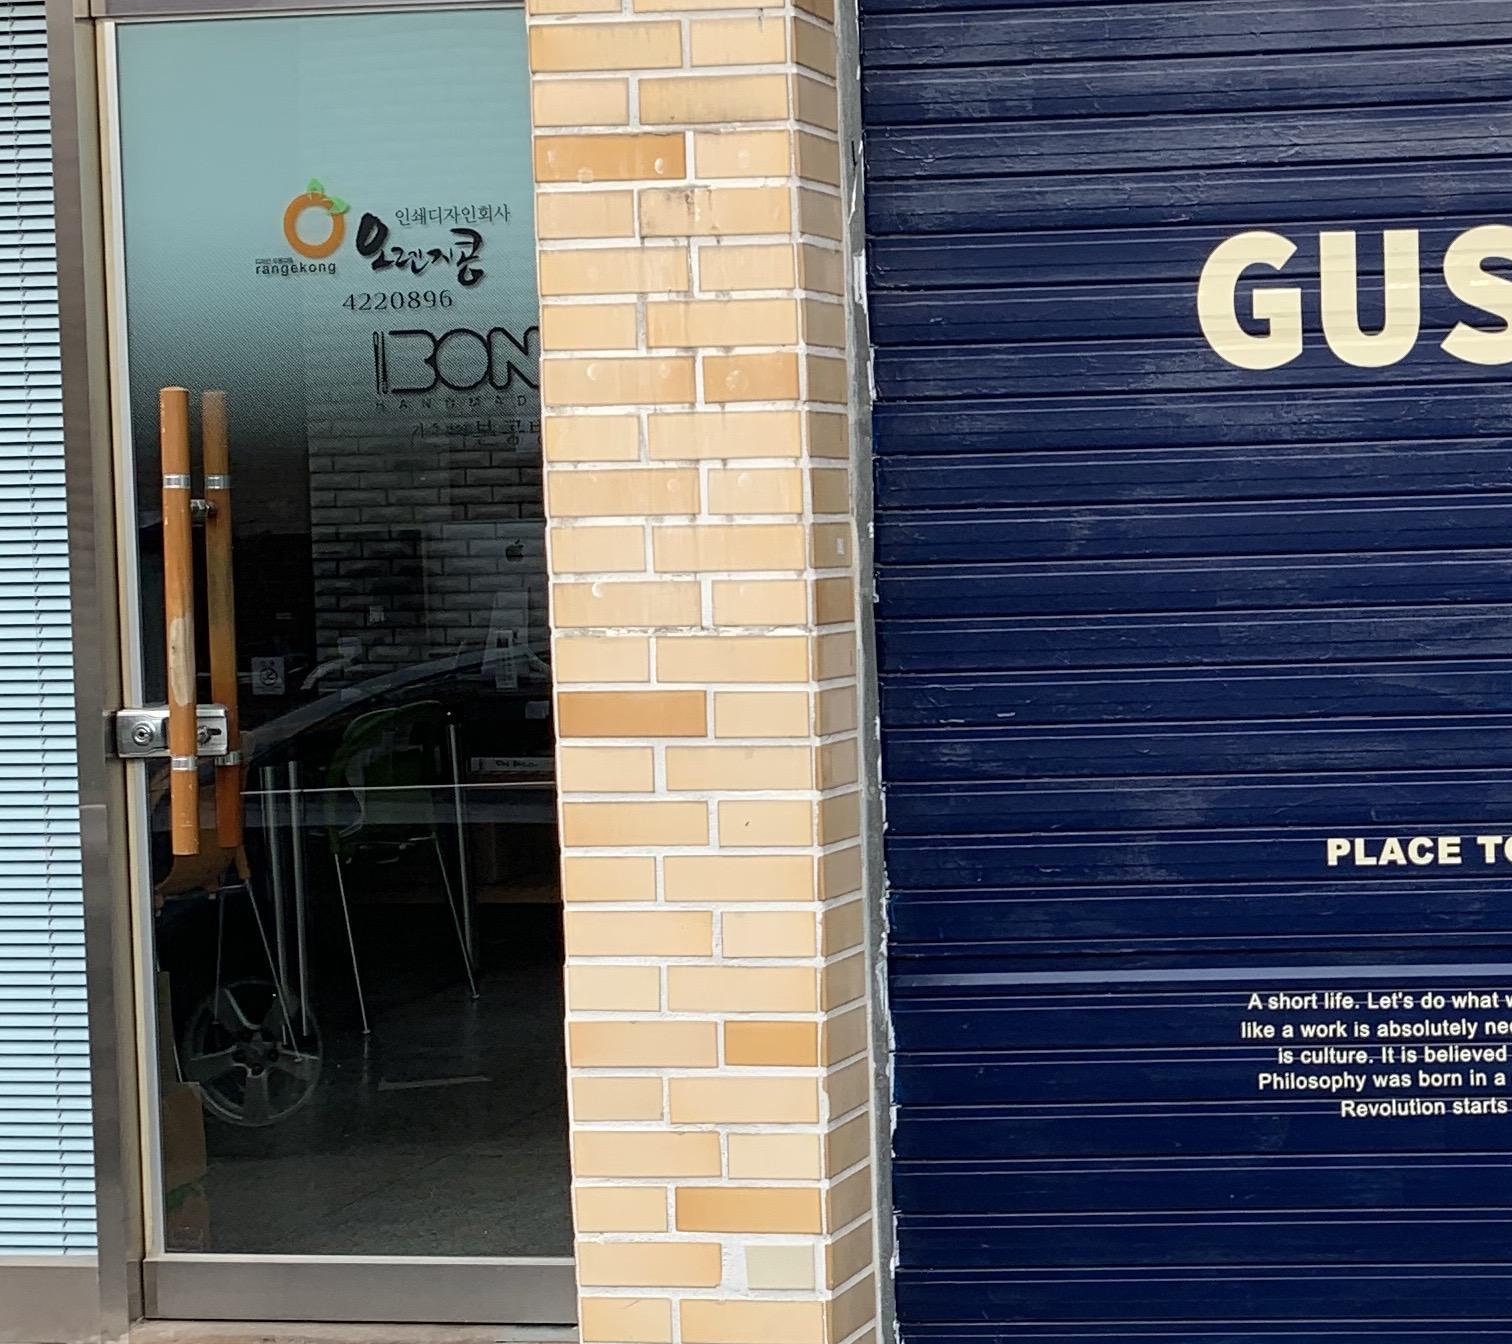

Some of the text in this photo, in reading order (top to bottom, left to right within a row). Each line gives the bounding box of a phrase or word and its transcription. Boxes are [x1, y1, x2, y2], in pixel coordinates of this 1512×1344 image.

[395, 203, 511, 227] 인쇄디자인회사
[355, 212, 485, 287] 오렌지콩
[342, 289, 454, 311] 4220896
[1327, 836, 1462, 866] PLACE
[1248, 992, 1263, 1009] A
[1268, 991, 1318, 1010] short
[1324, 991, 1359, 1009] life.
[1367, 991, 1414, 1009] Let's
[1420, 992, 1446, 1009] do
[1451, 991, 1500, 1009] what
[1241, 1021, 1275, 1038] like
[1282, 1024, 1294, 1038] a
[1300, 1020, 1347, 1038] work
[1354, 1023, 1370, 1038] is
[1377, 1019, 1478, 1040] absolutely
[1278, 1047, 1294, 1064] is
[1300, 1046, 1373, 1064] culture.
[1381, 1046, 1395, 1064] It
[1401, 1045, 1418, 1063] is
[1424, 1044, 1507, 1063] believed
[1258, 1071, 1366, 1093] Philosophy
[1372, 1074, 1412, 1088] was
[1418, 1070, 1463, 1087] born
[1470, 1070, 1487, 1086] in
[1494, 1072, 1506, 1086] a
[1341, 1098, 1446, 1117] Revolution
[1452, 1097, 1508, 1115] starts
